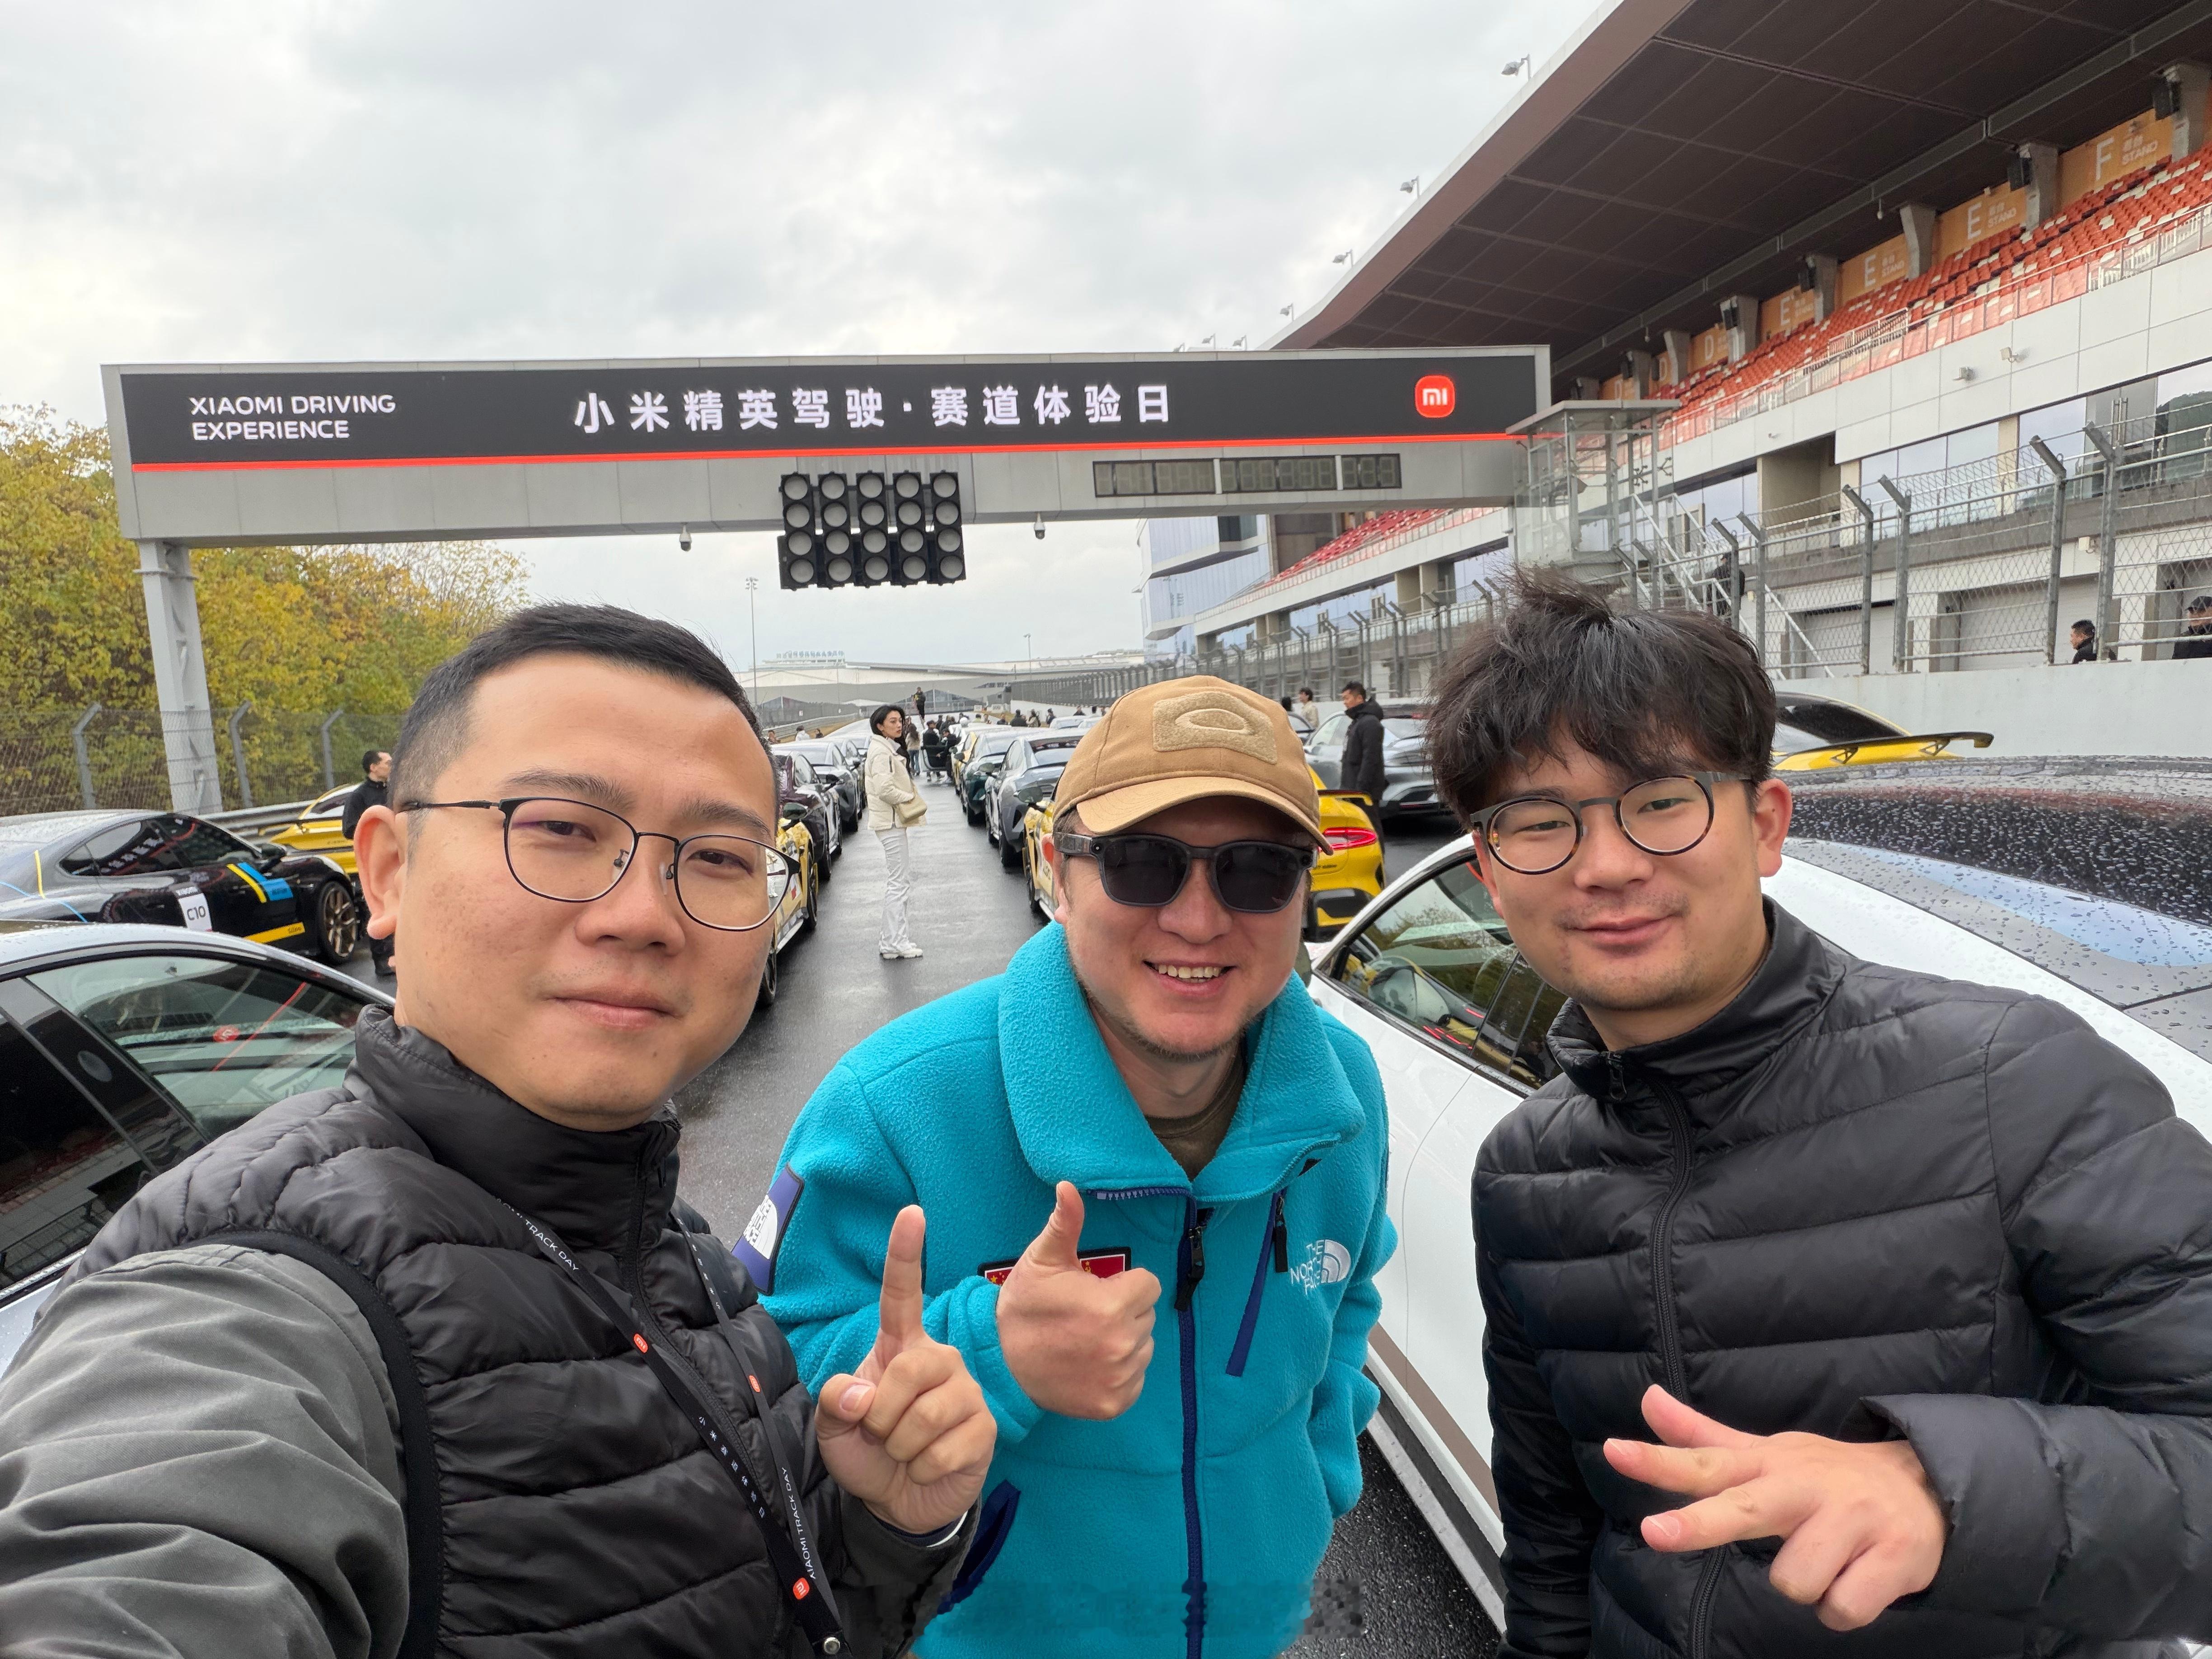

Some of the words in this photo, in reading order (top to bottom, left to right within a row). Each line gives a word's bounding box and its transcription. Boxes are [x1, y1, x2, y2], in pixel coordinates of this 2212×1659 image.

[2095, 136, 2115, 182] F
[1968, 202, 1982, 240] E
[1865, 254, 1876, 287] E
[1781, 295, 1790, 325] E
[189, 396, 283, 415] XIAOMI
[291, 394, 396, 414] DRIVING
[192, 420, 350, 441] EXPERIENCE
[187, 906, 206, 920] C10
[525, 1219, 558, 1251] TRACK
[558, 1251, 580, 1270] DAY
[782, 1467, 792, 1492] DAY
[788, 1495, 804, 1535] TRACK
